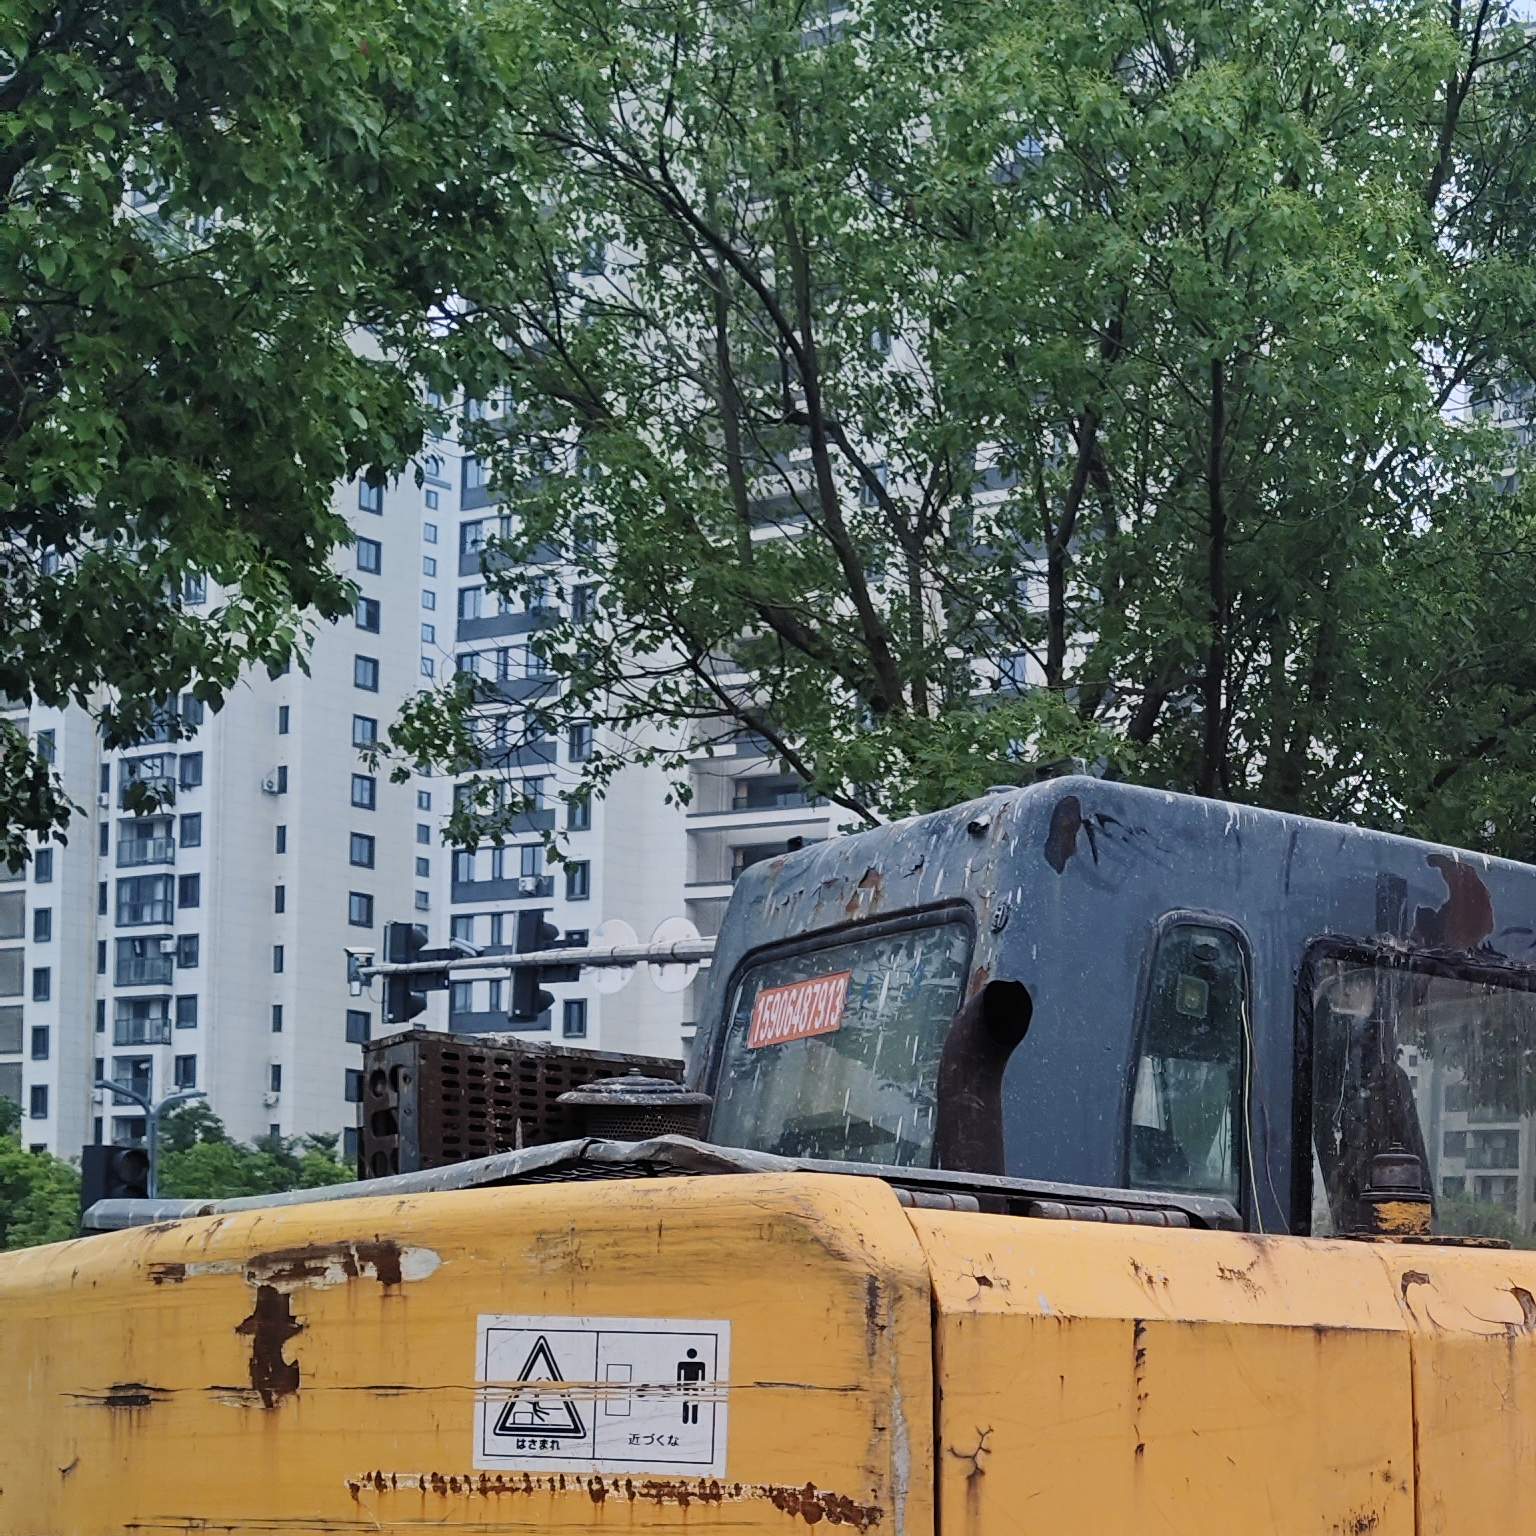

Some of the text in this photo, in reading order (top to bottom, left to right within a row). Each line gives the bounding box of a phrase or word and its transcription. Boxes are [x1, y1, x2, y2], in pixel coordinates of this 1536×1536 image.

[516, 1439, 560, 1450] はさまれ
[628, 1433, 679, 1447] 近づくな
